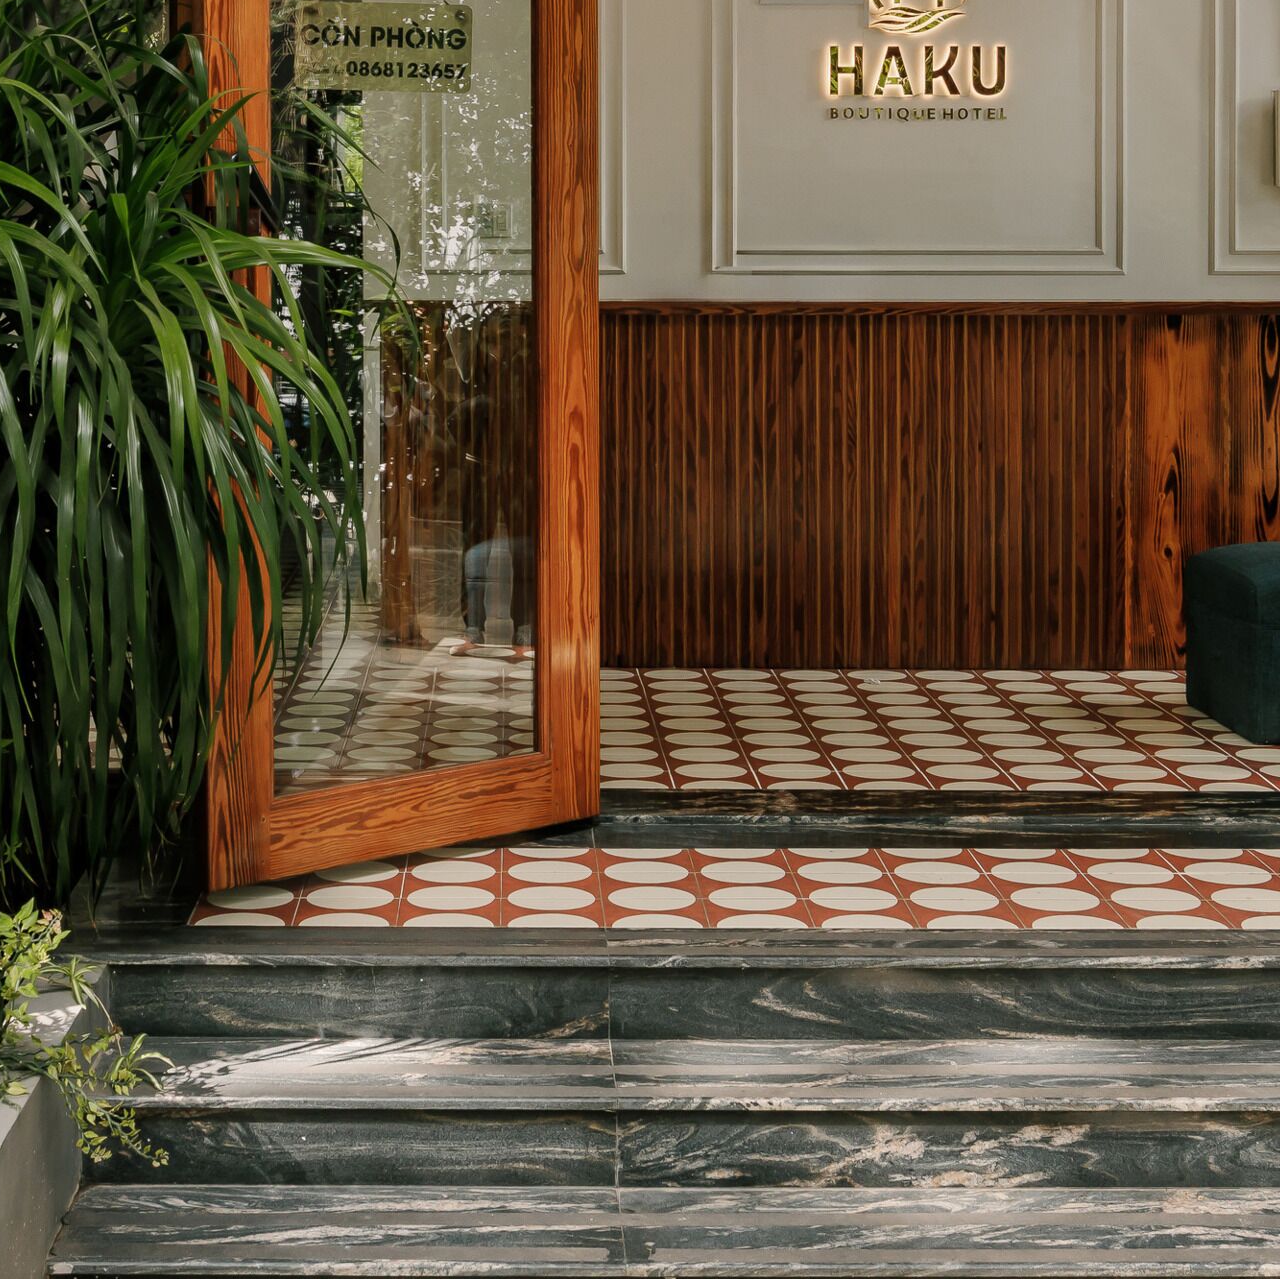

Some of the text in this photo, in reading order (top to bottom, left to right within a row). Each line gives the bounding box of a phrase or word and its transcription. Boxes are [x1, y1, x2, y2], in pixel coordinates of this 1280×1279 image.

[300, 19, 467, 50] CÒN PHÒNG
[829, 46, 1007, 96] HAKU
[830, 107, 1008, 121] BOUTIQUE HOTEL
